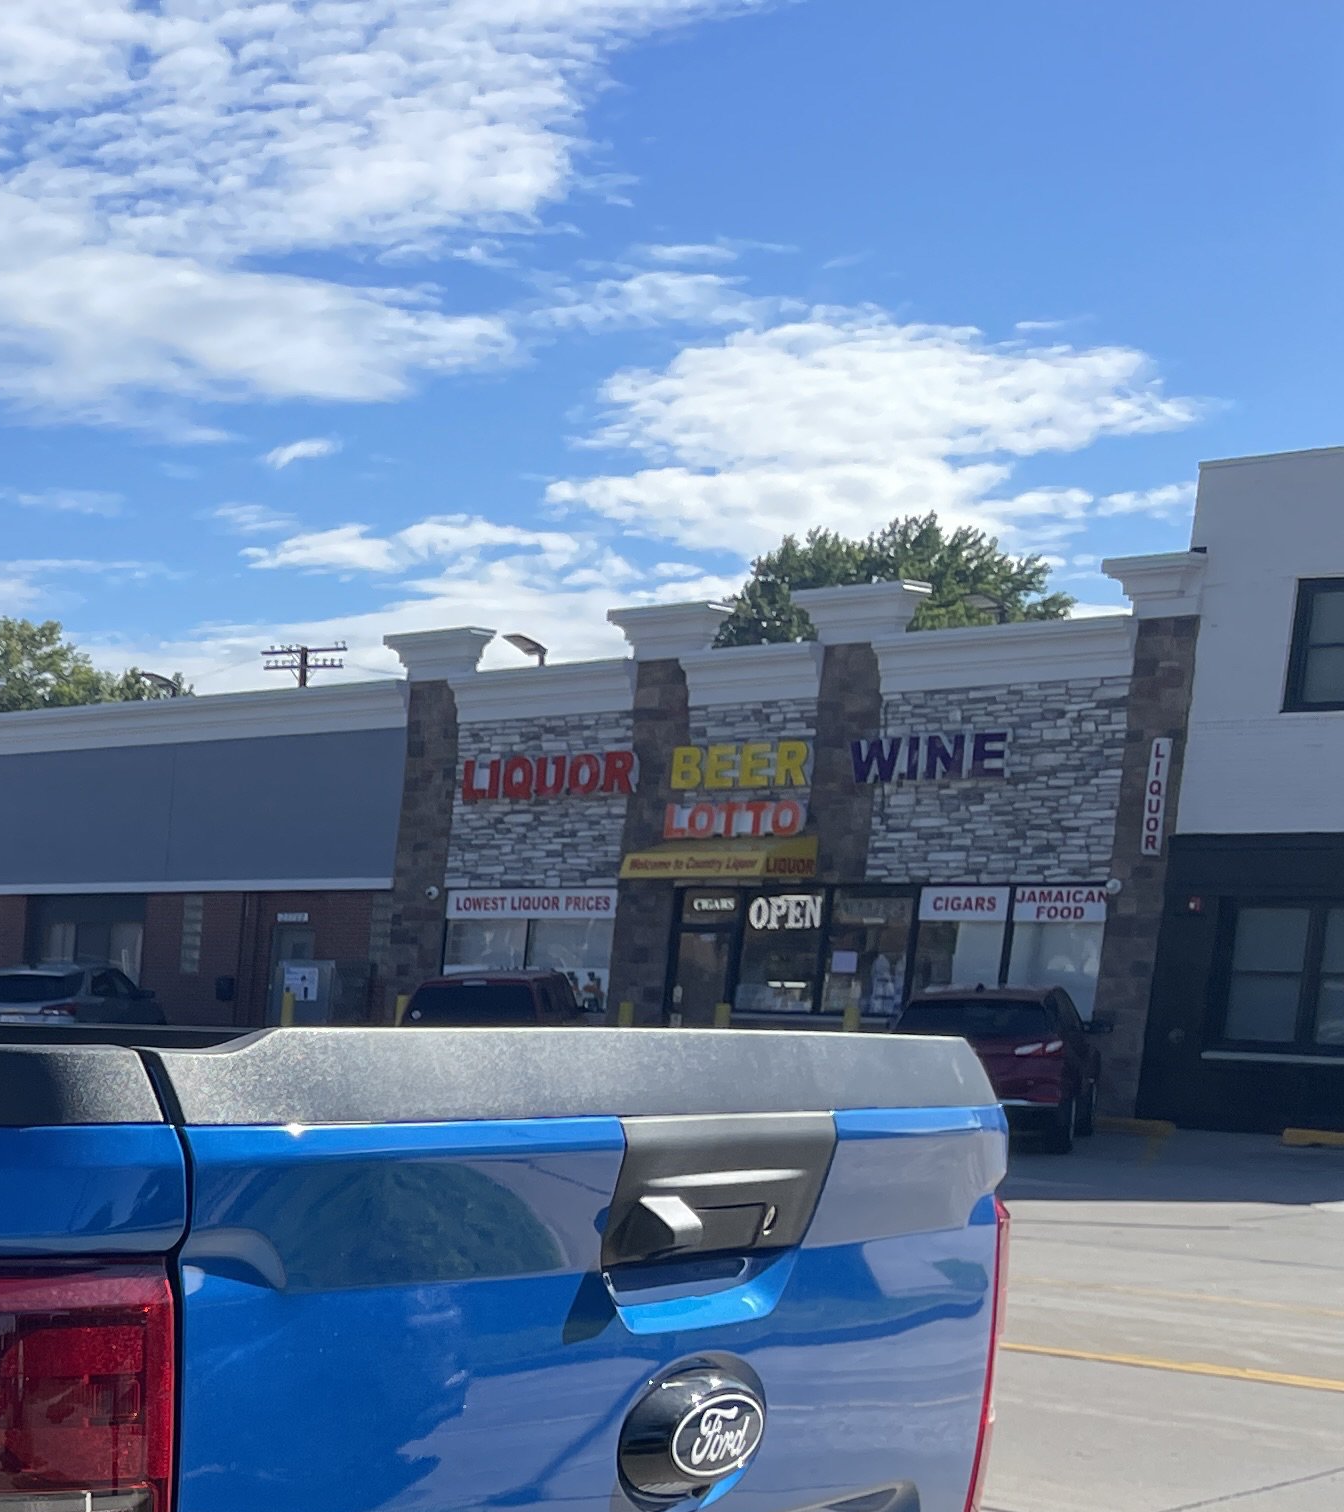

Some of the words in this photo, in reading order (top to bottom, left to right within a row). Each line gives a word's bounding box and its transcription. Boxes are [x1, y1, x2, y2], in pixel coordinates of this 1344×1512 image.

[670, 740, 809, 790] BEER
[850, 732, 1008, 784] WINE
[462, 751, 635, 804] LIQUOR
[1145, 743, 1165, 850] LIQUOR
[664, 800, 801, 838] LOTTO
[629, 857, 672, 871] Welcome
[673, 858, 683, 870] to
[726, 857, 758, 872] Liquor
[765, 857, 815, 874] LIQUOR
[456, 896, 507, 911] LOWEST
[511, 896, 560, 911] LIQUOR
[564, 895, 611, 911] PRICES
[693, 897, 736, 911] CIGARS
[932, 896, 997, 912] CIGARS
[1015, 890, 1109, 904] JAMAICAN
[748, 895, 823, 930] OPEN
[1036, 906, 1085, 920] FOOD
[691, 1405, 750, 1466] Ford
